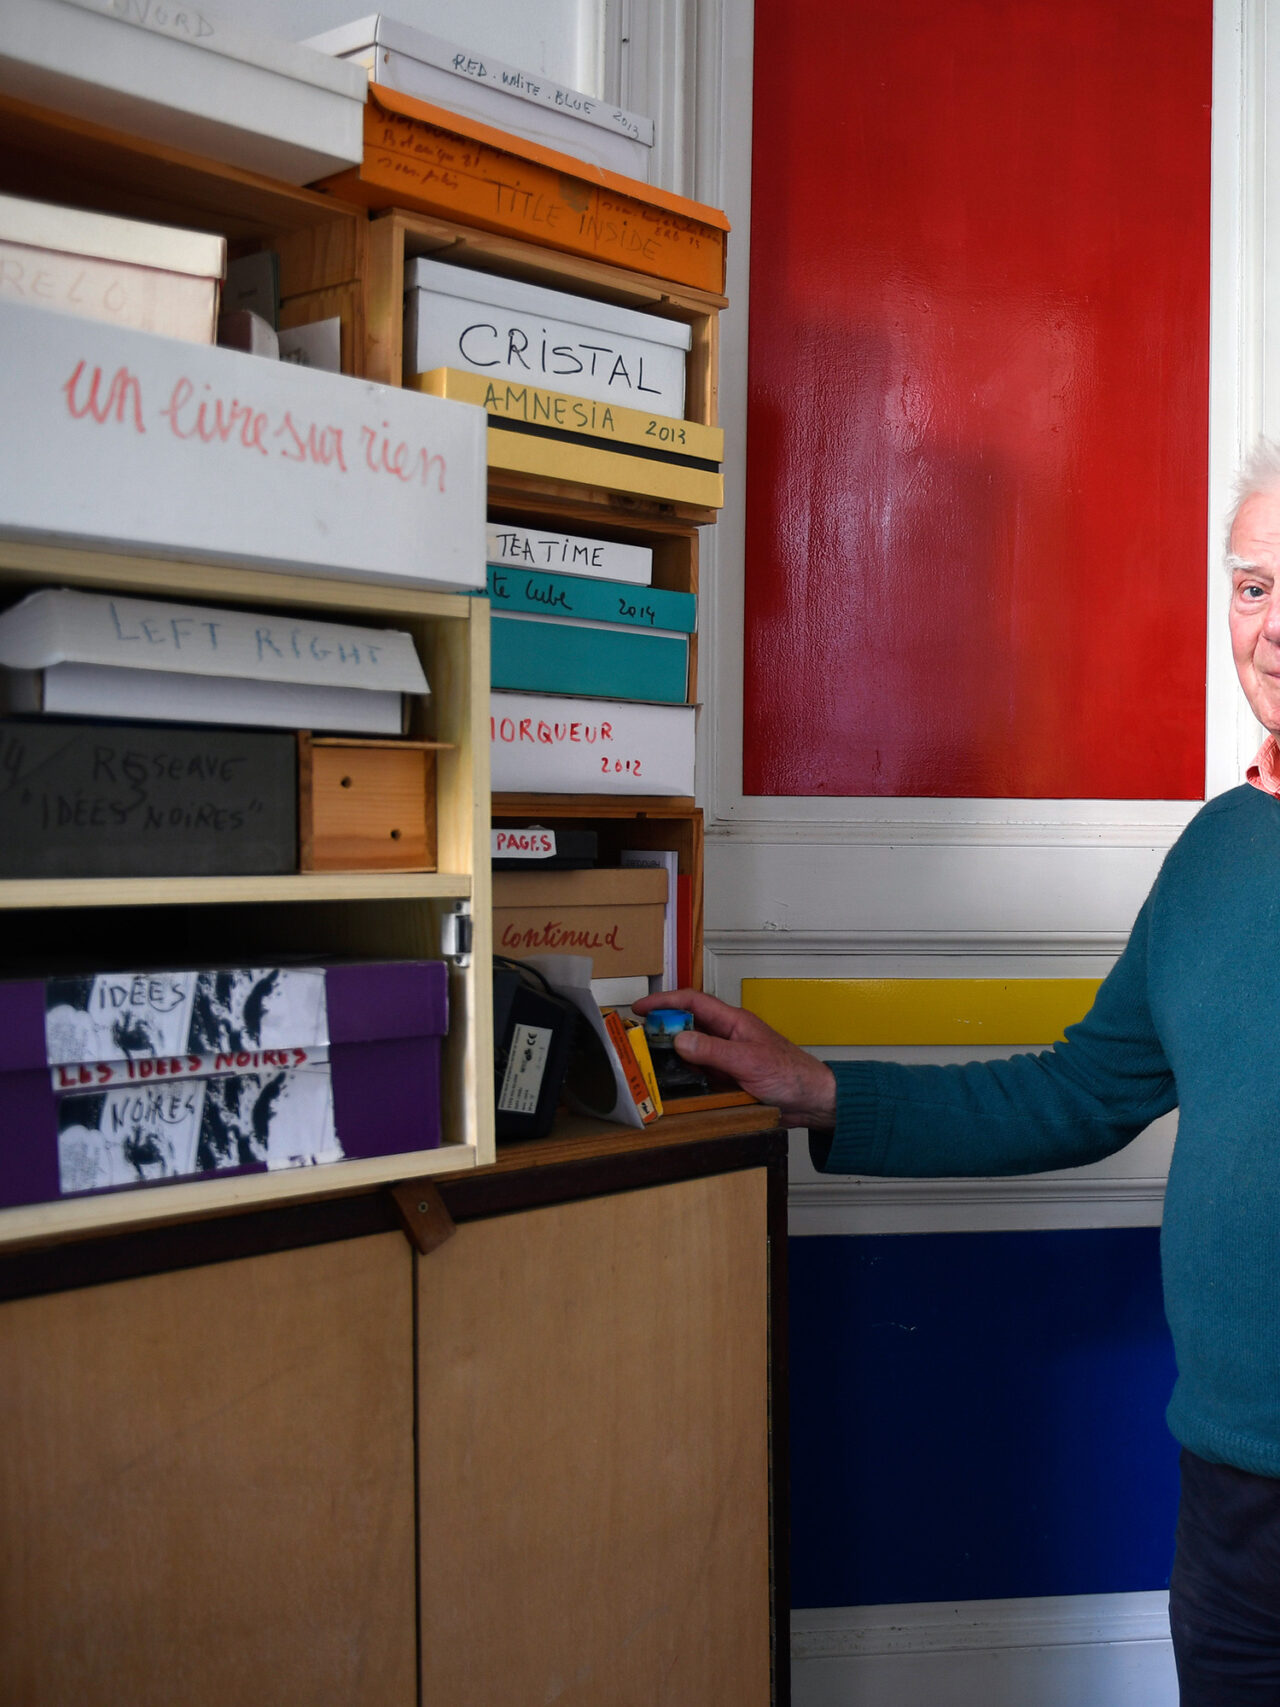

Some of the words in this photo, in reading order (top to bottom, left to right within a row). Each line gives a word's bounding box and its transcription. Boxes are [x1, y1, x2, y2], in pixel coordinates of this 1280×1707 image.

[452, 54, 487, 77] RED
[612, 111, 640, 140] 2013
[645, 420, 687, 445] 2013
[619, 598, 656, 625] 2014
[110, 601, 221, 650] LEFT
[254, 627, 383, 666] RIGHT
[601, 757, 643, 777] 2012
[496, 832, 553, 852] PAGES
